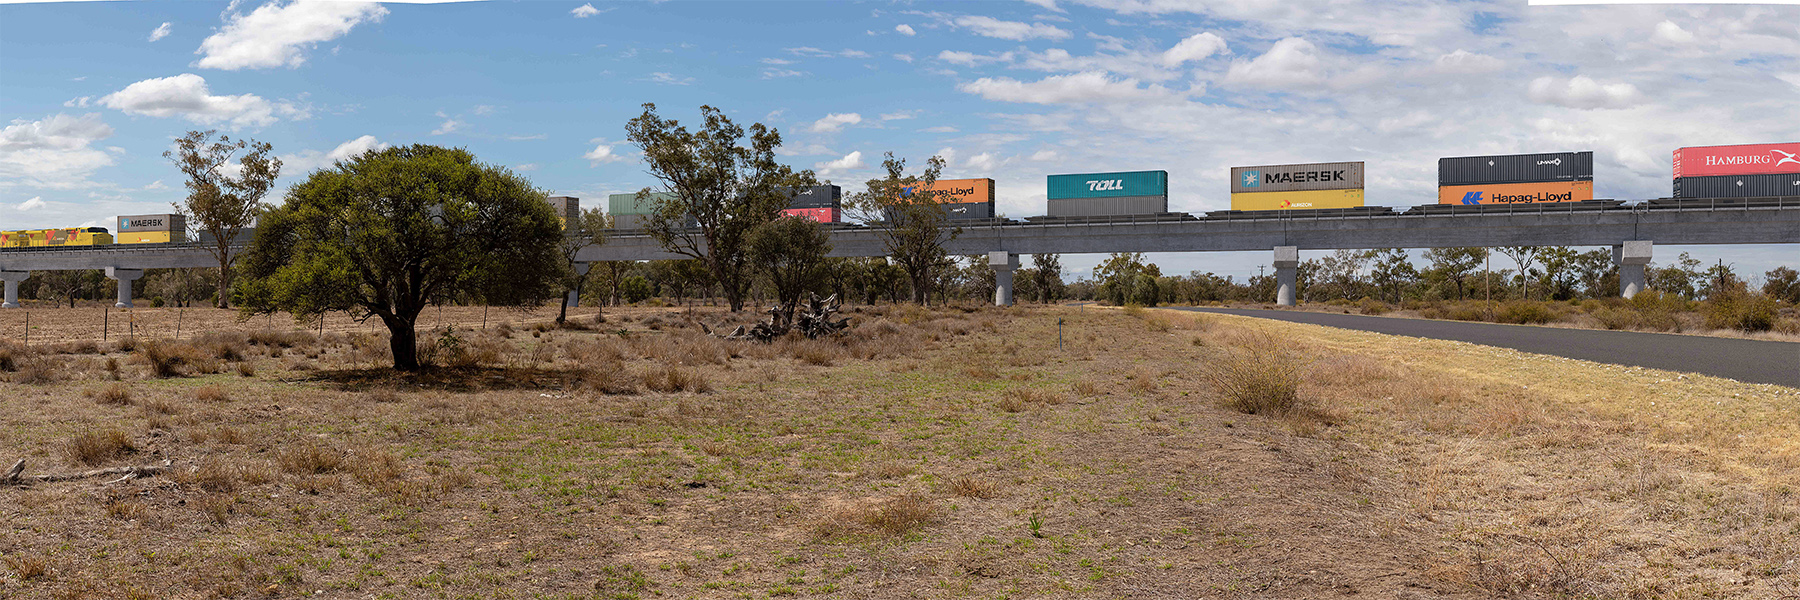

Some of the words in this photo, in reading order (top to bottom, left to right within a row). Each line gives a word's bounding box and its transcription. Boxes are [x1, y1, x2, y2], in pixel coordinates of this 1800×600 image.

[1705, 155, 1770, 166] HAMBURG
[1265, 170, 1346, 184] MAERSK
[1085, 179, 1123, 191] TOLL
[919, 187, 974, 197] pag-Lloyd
[1492, 191, 1572, 204] Hapag-Lloyd
[130, 219, 163, 227] MAERSK
